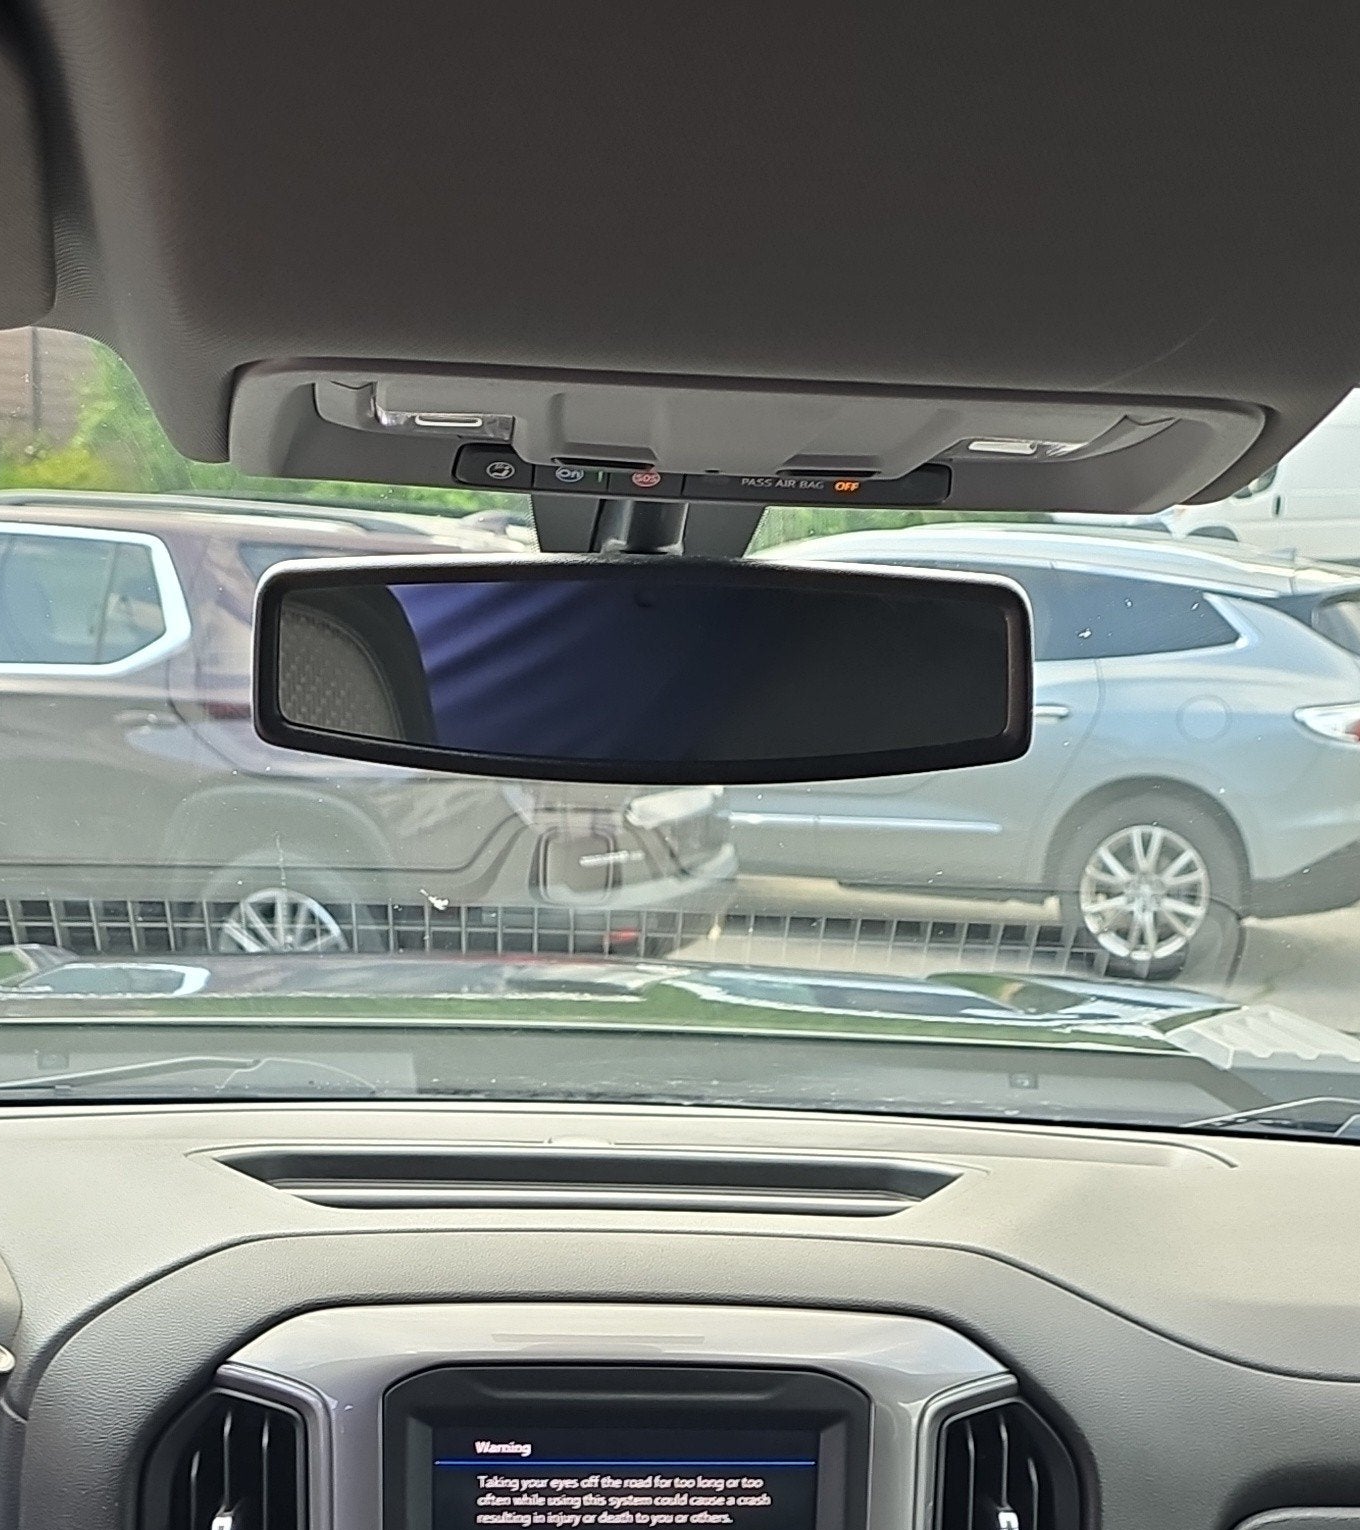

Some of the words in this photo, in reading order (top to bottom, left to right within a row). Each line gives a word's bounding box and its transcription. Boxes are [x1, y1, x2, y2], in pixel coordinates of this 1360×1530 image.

[634, 472, 657, 484] SOS
[741, 477, 773, 488] PASS
[776, 478, 796, 489] AIR
[799, 480, 825, 491] BAG
[835, 481, 860, 492] OFF
[475, 1441, 532, 1456] Warning
[477, 1476, 520, 1491] Taking
[520, 1478, 549, 1491] your
[550, 1478, 579, 1491] eyes
[580, 1476, 599, 1488] off
[600, 1476, 622, 1488] the
[624, 1476, 652, 1488] road
[654, 1476, 674, 1488] for
[674, 1477, 695, 1488] too
[696, 1476, 724, 1491] long
[726, 1478, 742, 1488] or
[742, 1477, 764, 1488] too
[477, 1494, 512, 1506] often
[513, 1494, 545, 1506] while
[547, 1494, 582, 1508] using
[582, 1494, 606, 1506] this
[608, 1495, 652, 1508] system
[654, 1494, 688, 1506] could
[689, 1496, 725, 1506] cause
[726, 1496, 735, 1506] a
[736, 1494, 771, 1506] crash
[476, 1512, 532, 1527] resulting
[532, 1512, 545, 1524] in
[546, 1512, 582, 1527] injury
[582, 1514, 596, 1524] or
[598, 1512, 634, 1524] death
[635, 1512, 649, 1524] to
[649, 1514, 673, 1527] you
[674, 1514, 688, 1524] or
[690, 1512, 733, 1524] others.
